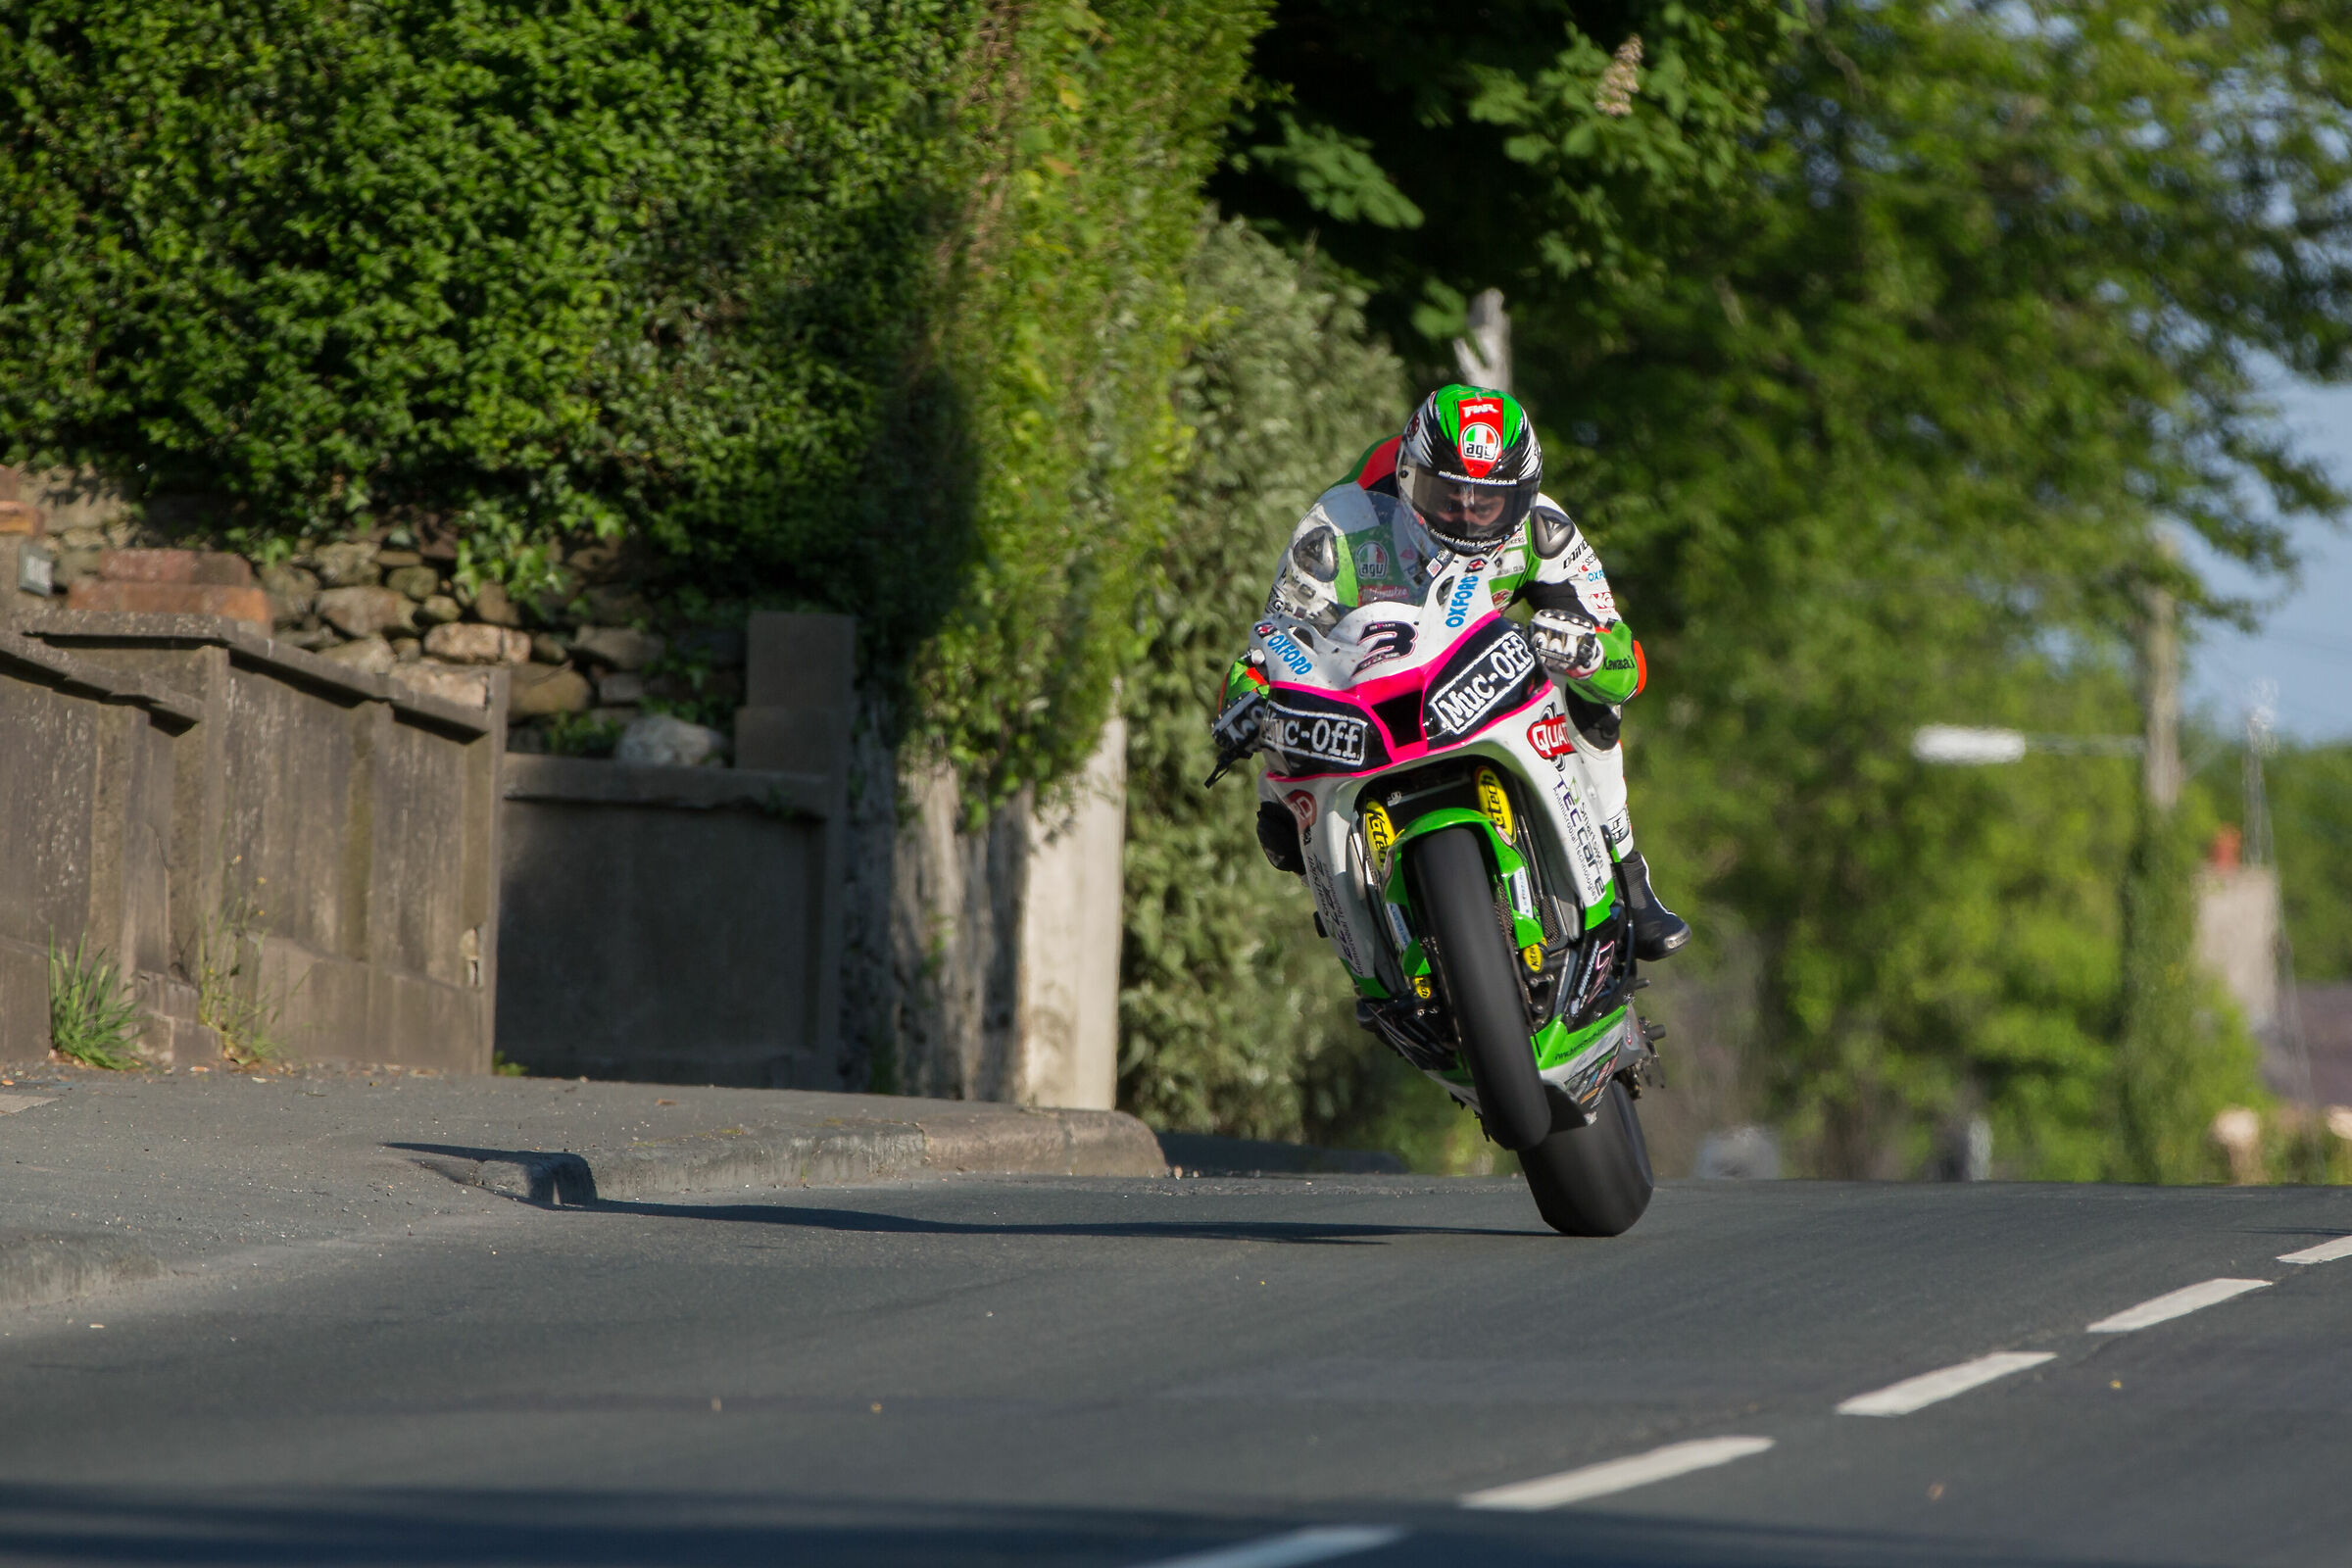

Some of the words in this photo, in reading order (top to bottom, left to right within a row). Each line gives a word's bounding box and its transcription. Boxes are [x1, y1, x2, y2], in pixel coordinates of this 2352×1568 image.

[1455, 538, 1476, 548] Advice
[1361, 563, 1384, 578] agv
[1446, 574, 1480, 628] OXFORD
[1267, 634, 1313, 676] OXFORD
[1348, 620, 1419, 682] 3
[1438, 634, 1532, 726] Muc-Off
[1552, 786, 1578, 843] Antimicrobial
[1574, 841, 1599, 902] Technologies
